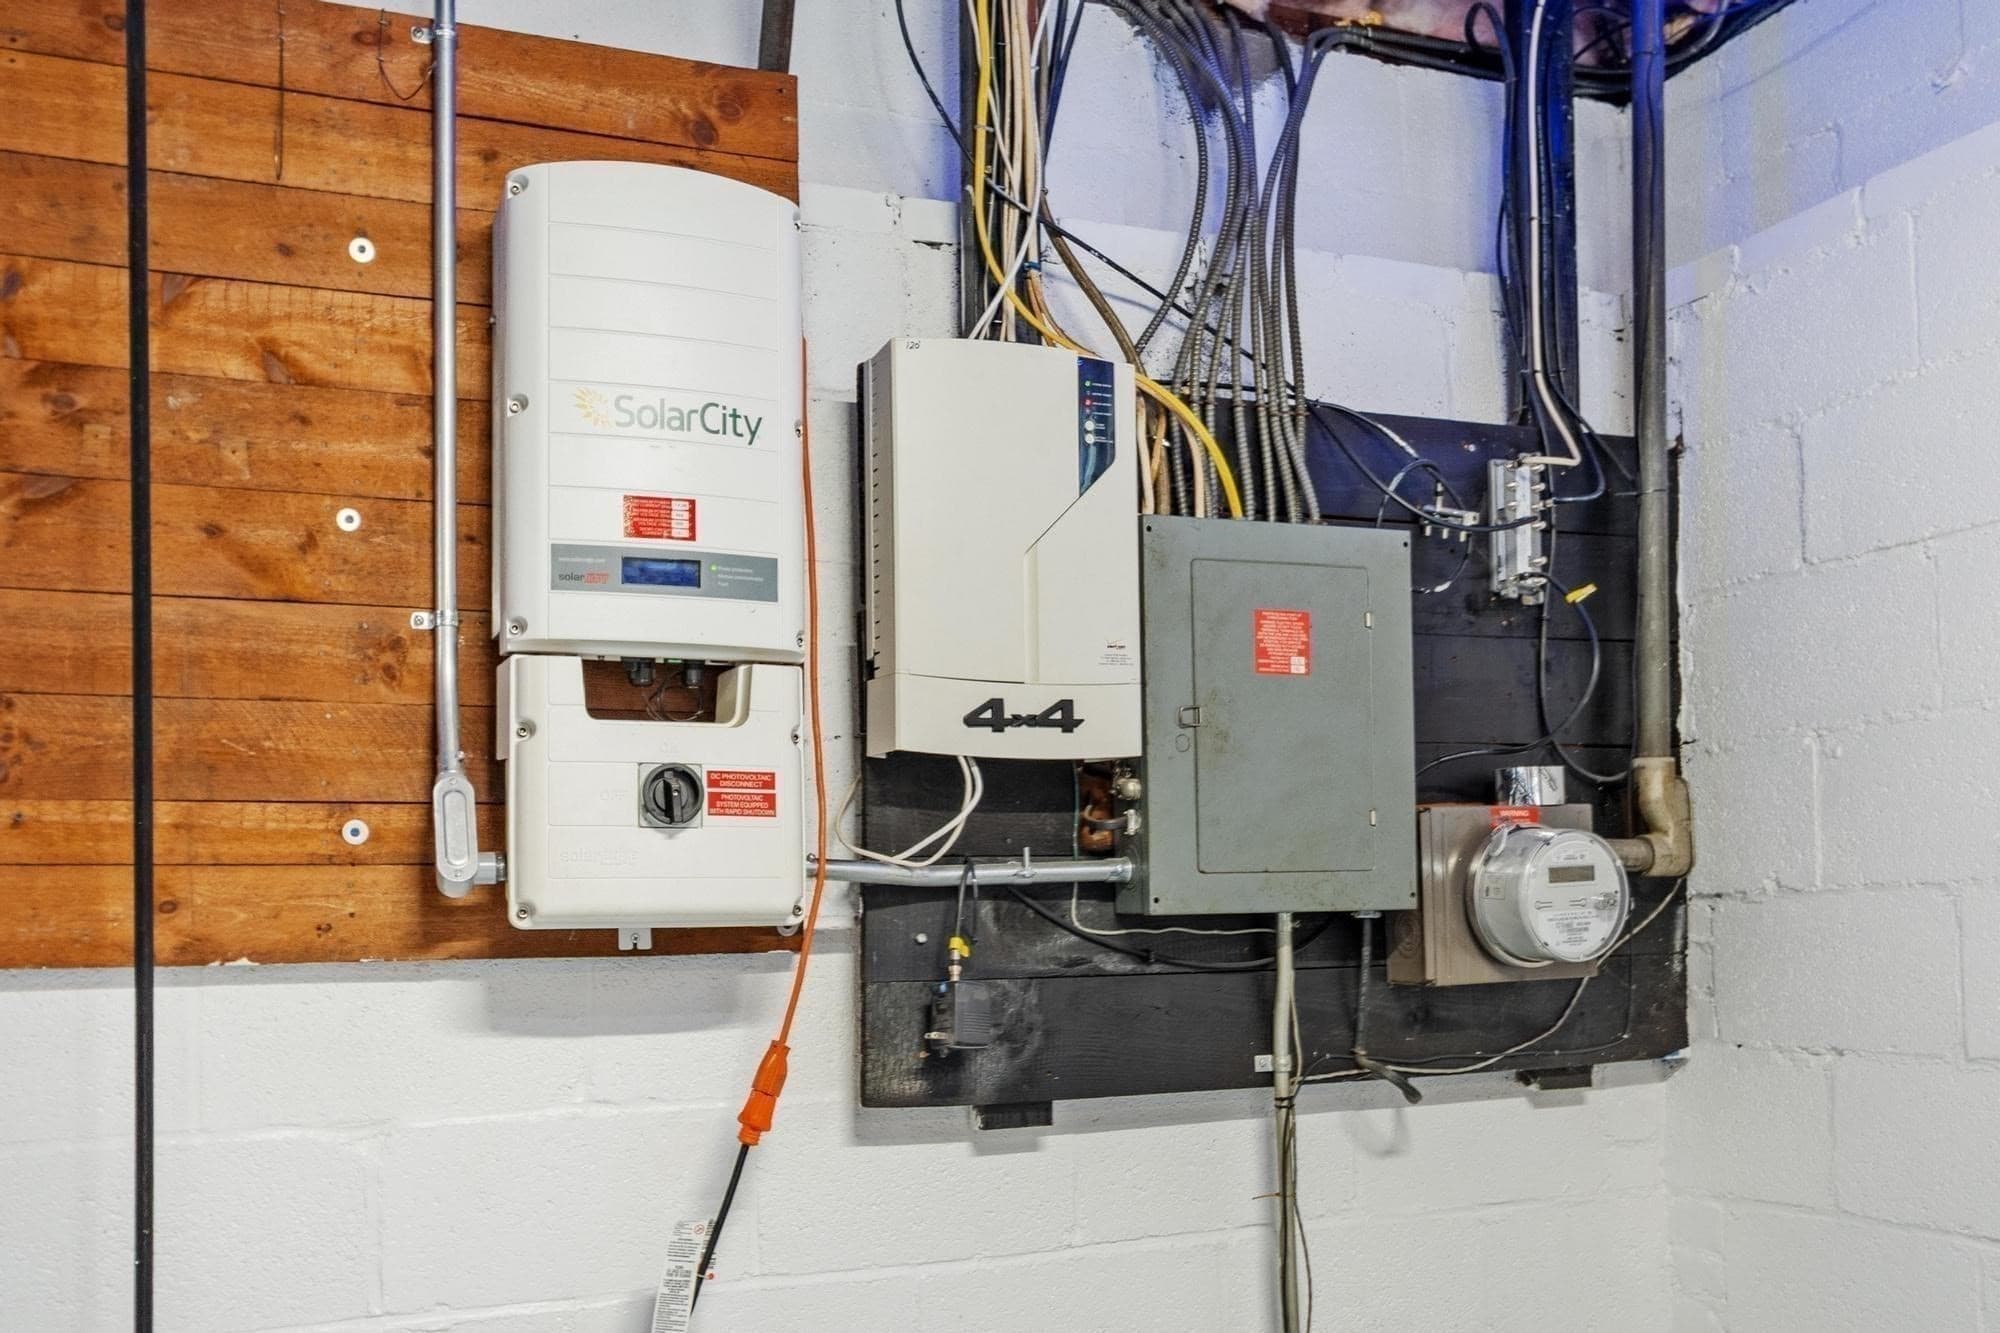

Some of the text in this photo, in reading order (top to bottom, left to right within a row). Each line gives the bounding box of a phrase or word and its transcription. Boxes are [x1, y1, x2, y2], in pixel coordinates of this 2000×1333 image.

[614, 394, 763, 446] SolarCity
[710, 772, 772, 781] DC PHOTOVOLTAIC
[719, 780, 763, 788] DISCONNECT
[721, 794, 764, 802] PHOTOVOLTAIC
